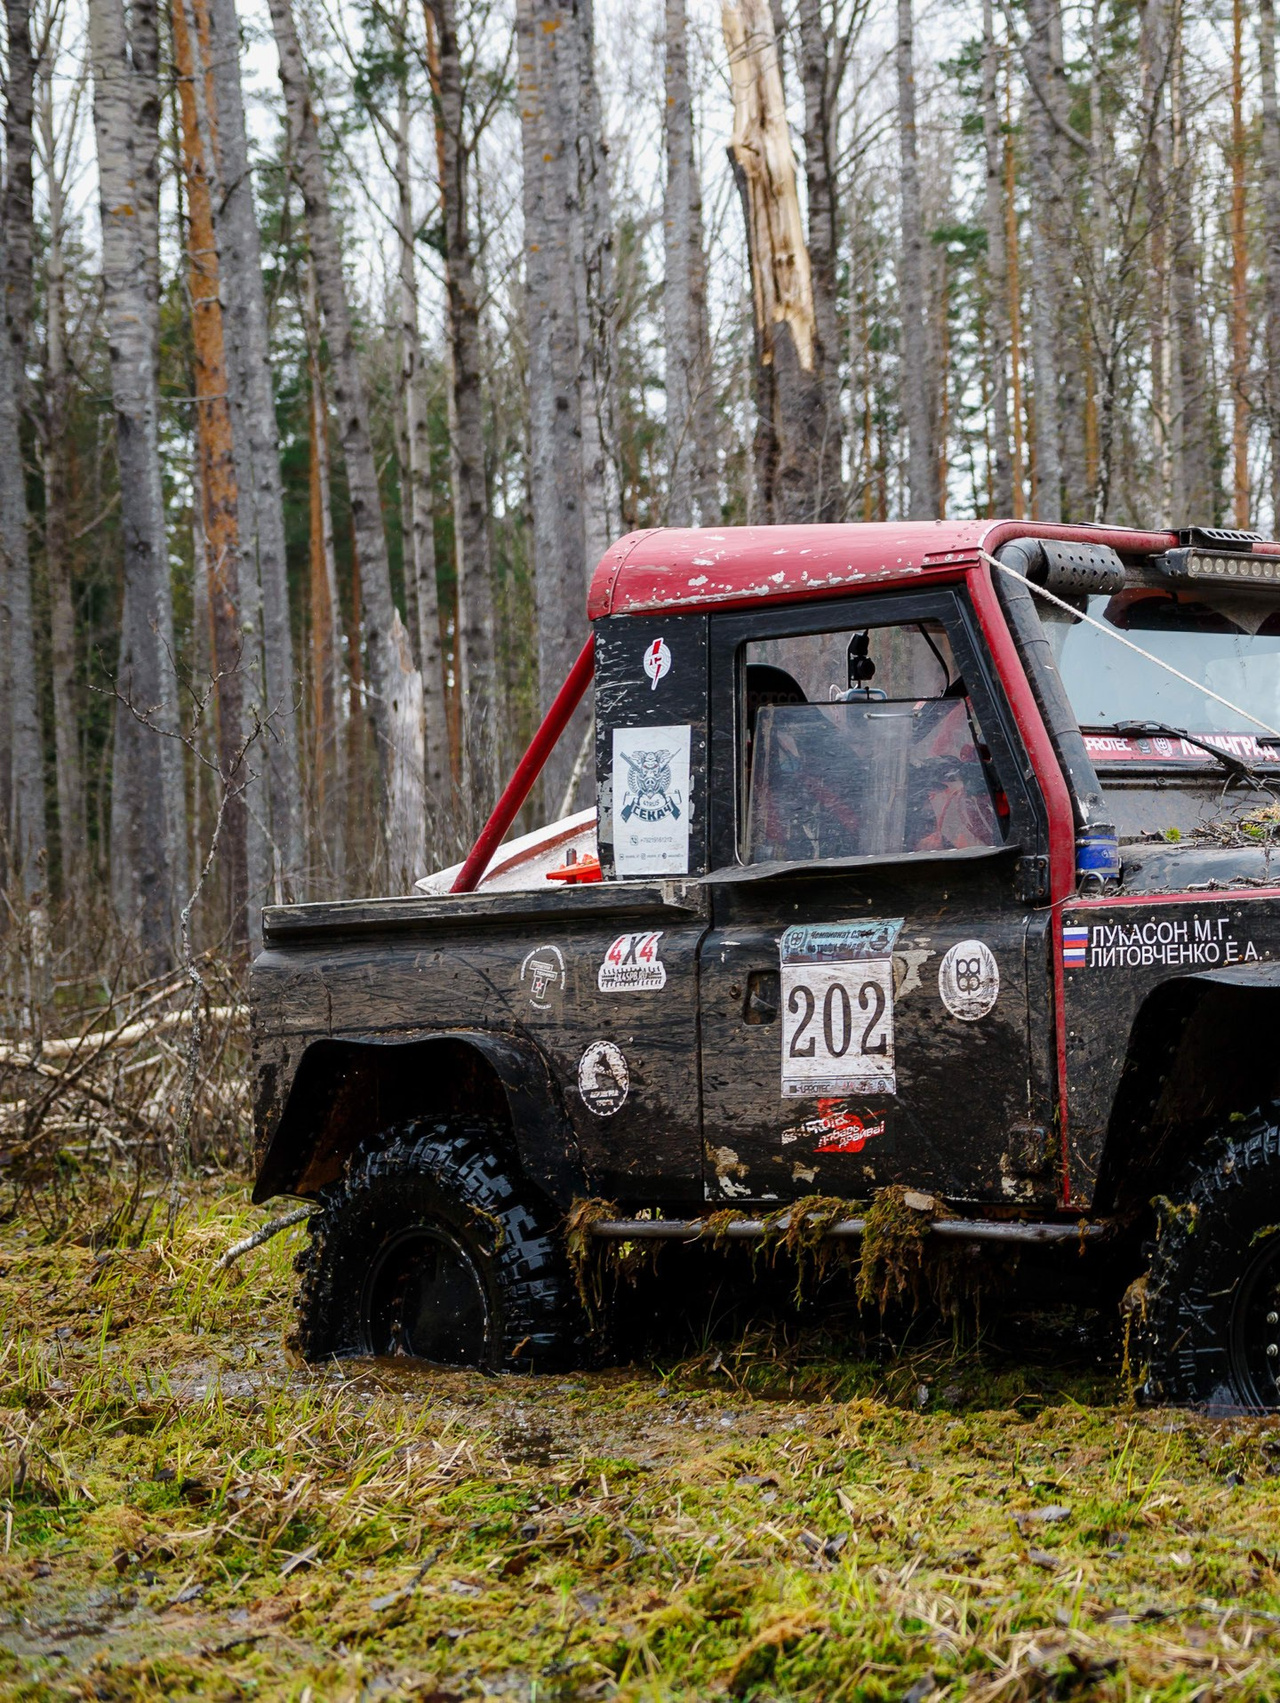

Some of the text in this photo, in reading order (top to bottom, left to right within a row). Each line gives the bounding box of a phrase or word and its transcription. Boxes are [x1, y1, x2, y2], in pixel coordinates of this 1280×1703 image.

[1084, 737, 1132, 751] PROTEC
[633, 804, 672, 821] СЕКАЧ
[1090, 918, 1233, 948] ЛУКАСОН М.Г.
[1089, 940, 1263, 968] ЛИТОВЧЕНКО ЕА.
[787, 980, 888, 1058] 202
